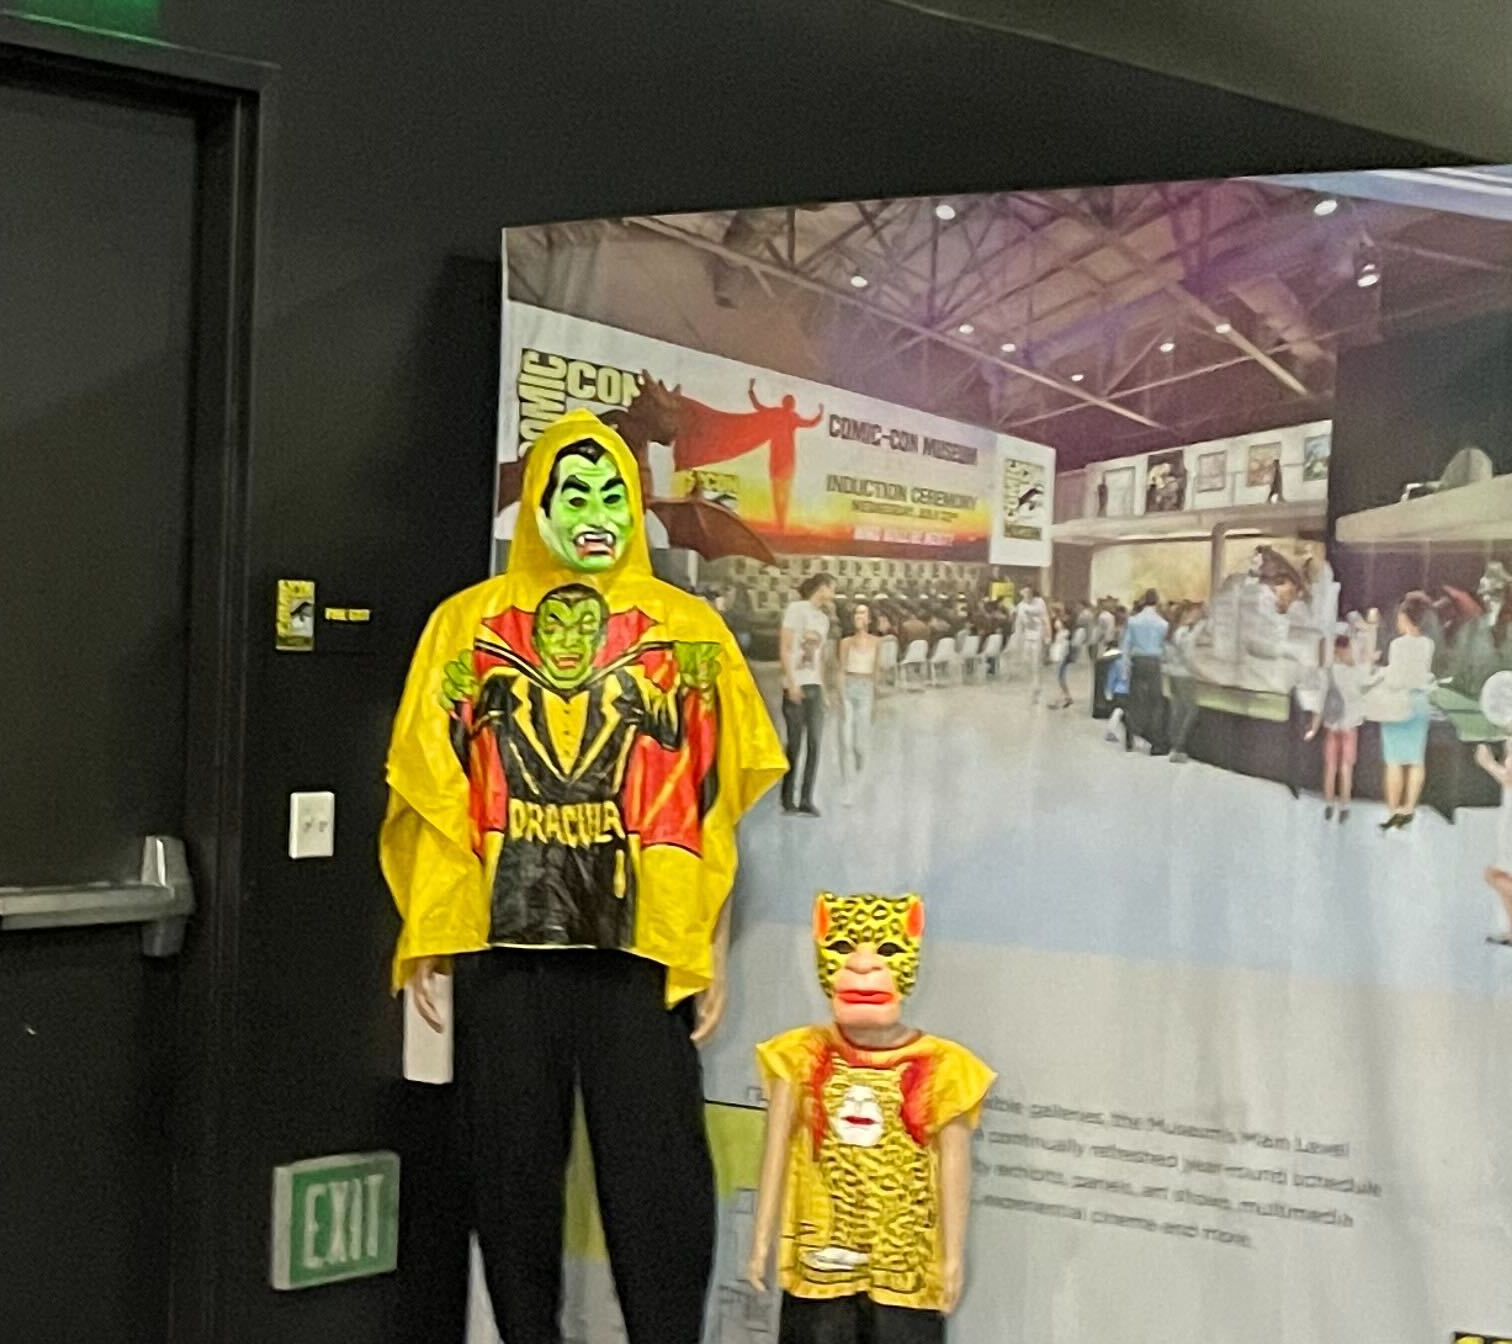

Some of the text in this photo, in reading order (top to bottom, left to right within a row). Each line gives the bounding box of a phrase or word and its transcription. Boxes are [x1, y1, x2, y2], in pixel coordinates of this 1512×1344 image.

[828, 413, 919, 453] COMIC-CON
[826, 474, 907, 501] INDUCTION
[509, 798, 626, 849] DRACULA
[303, 1174, 384, 1269] EXIT
